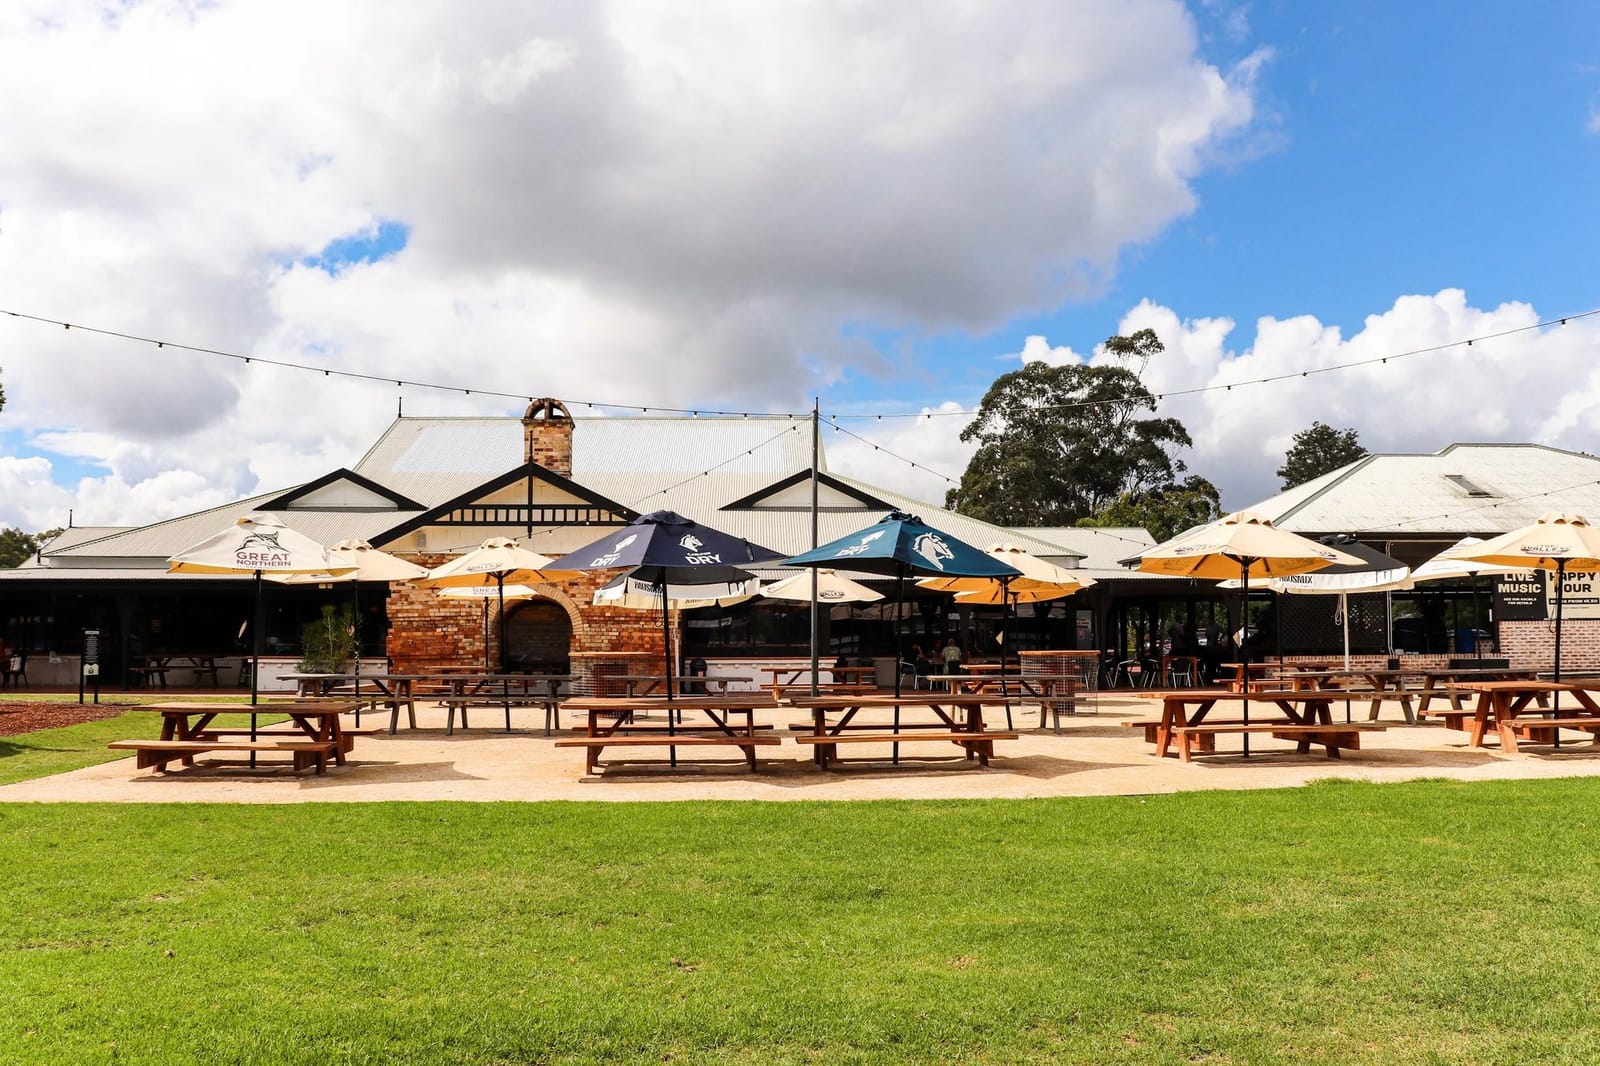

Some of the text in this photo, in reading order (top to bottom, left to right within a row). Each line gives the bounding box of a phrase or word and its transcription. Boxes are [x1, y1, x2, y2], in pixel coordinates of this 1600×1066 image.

[236, 552, 290, 561] GREAT
[589, 554, 621, 567] DRY
[685, 554, 722, 565] DRY
[1503, 573, 1535, 581] LIVE
[1498, 583, 1541, 593] MUSIC
